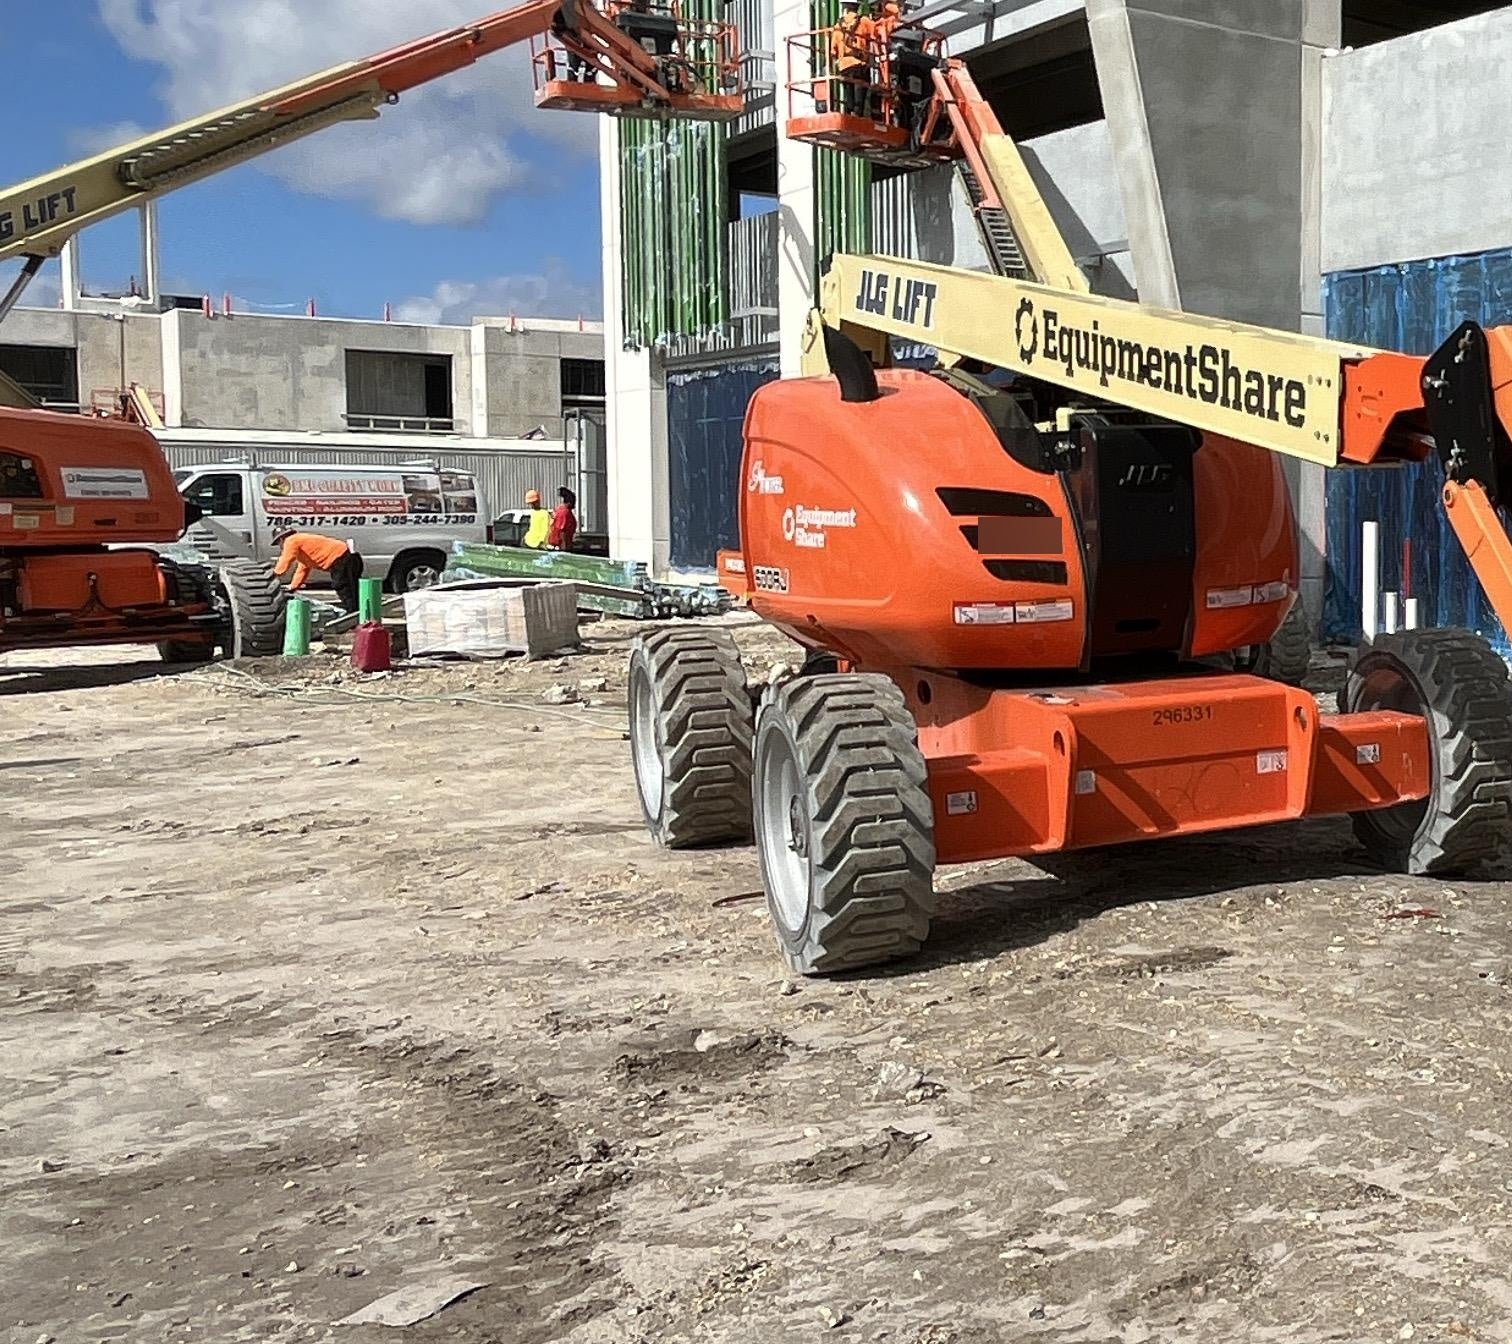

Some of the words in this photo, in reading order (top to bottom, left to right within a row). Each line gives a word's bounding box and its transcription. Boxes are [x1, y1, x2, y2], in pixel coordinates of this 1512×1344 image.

[22, 185, 77, 231] LIFT
[855, 269, 888, 317] JLG
[892, 278, 937, 330] LIFT
[1043, 310, 1307, 429] EquipmentShare
[796, 504, 857, 528] Equipment
[1152, 704, 1211, 726] 296331
